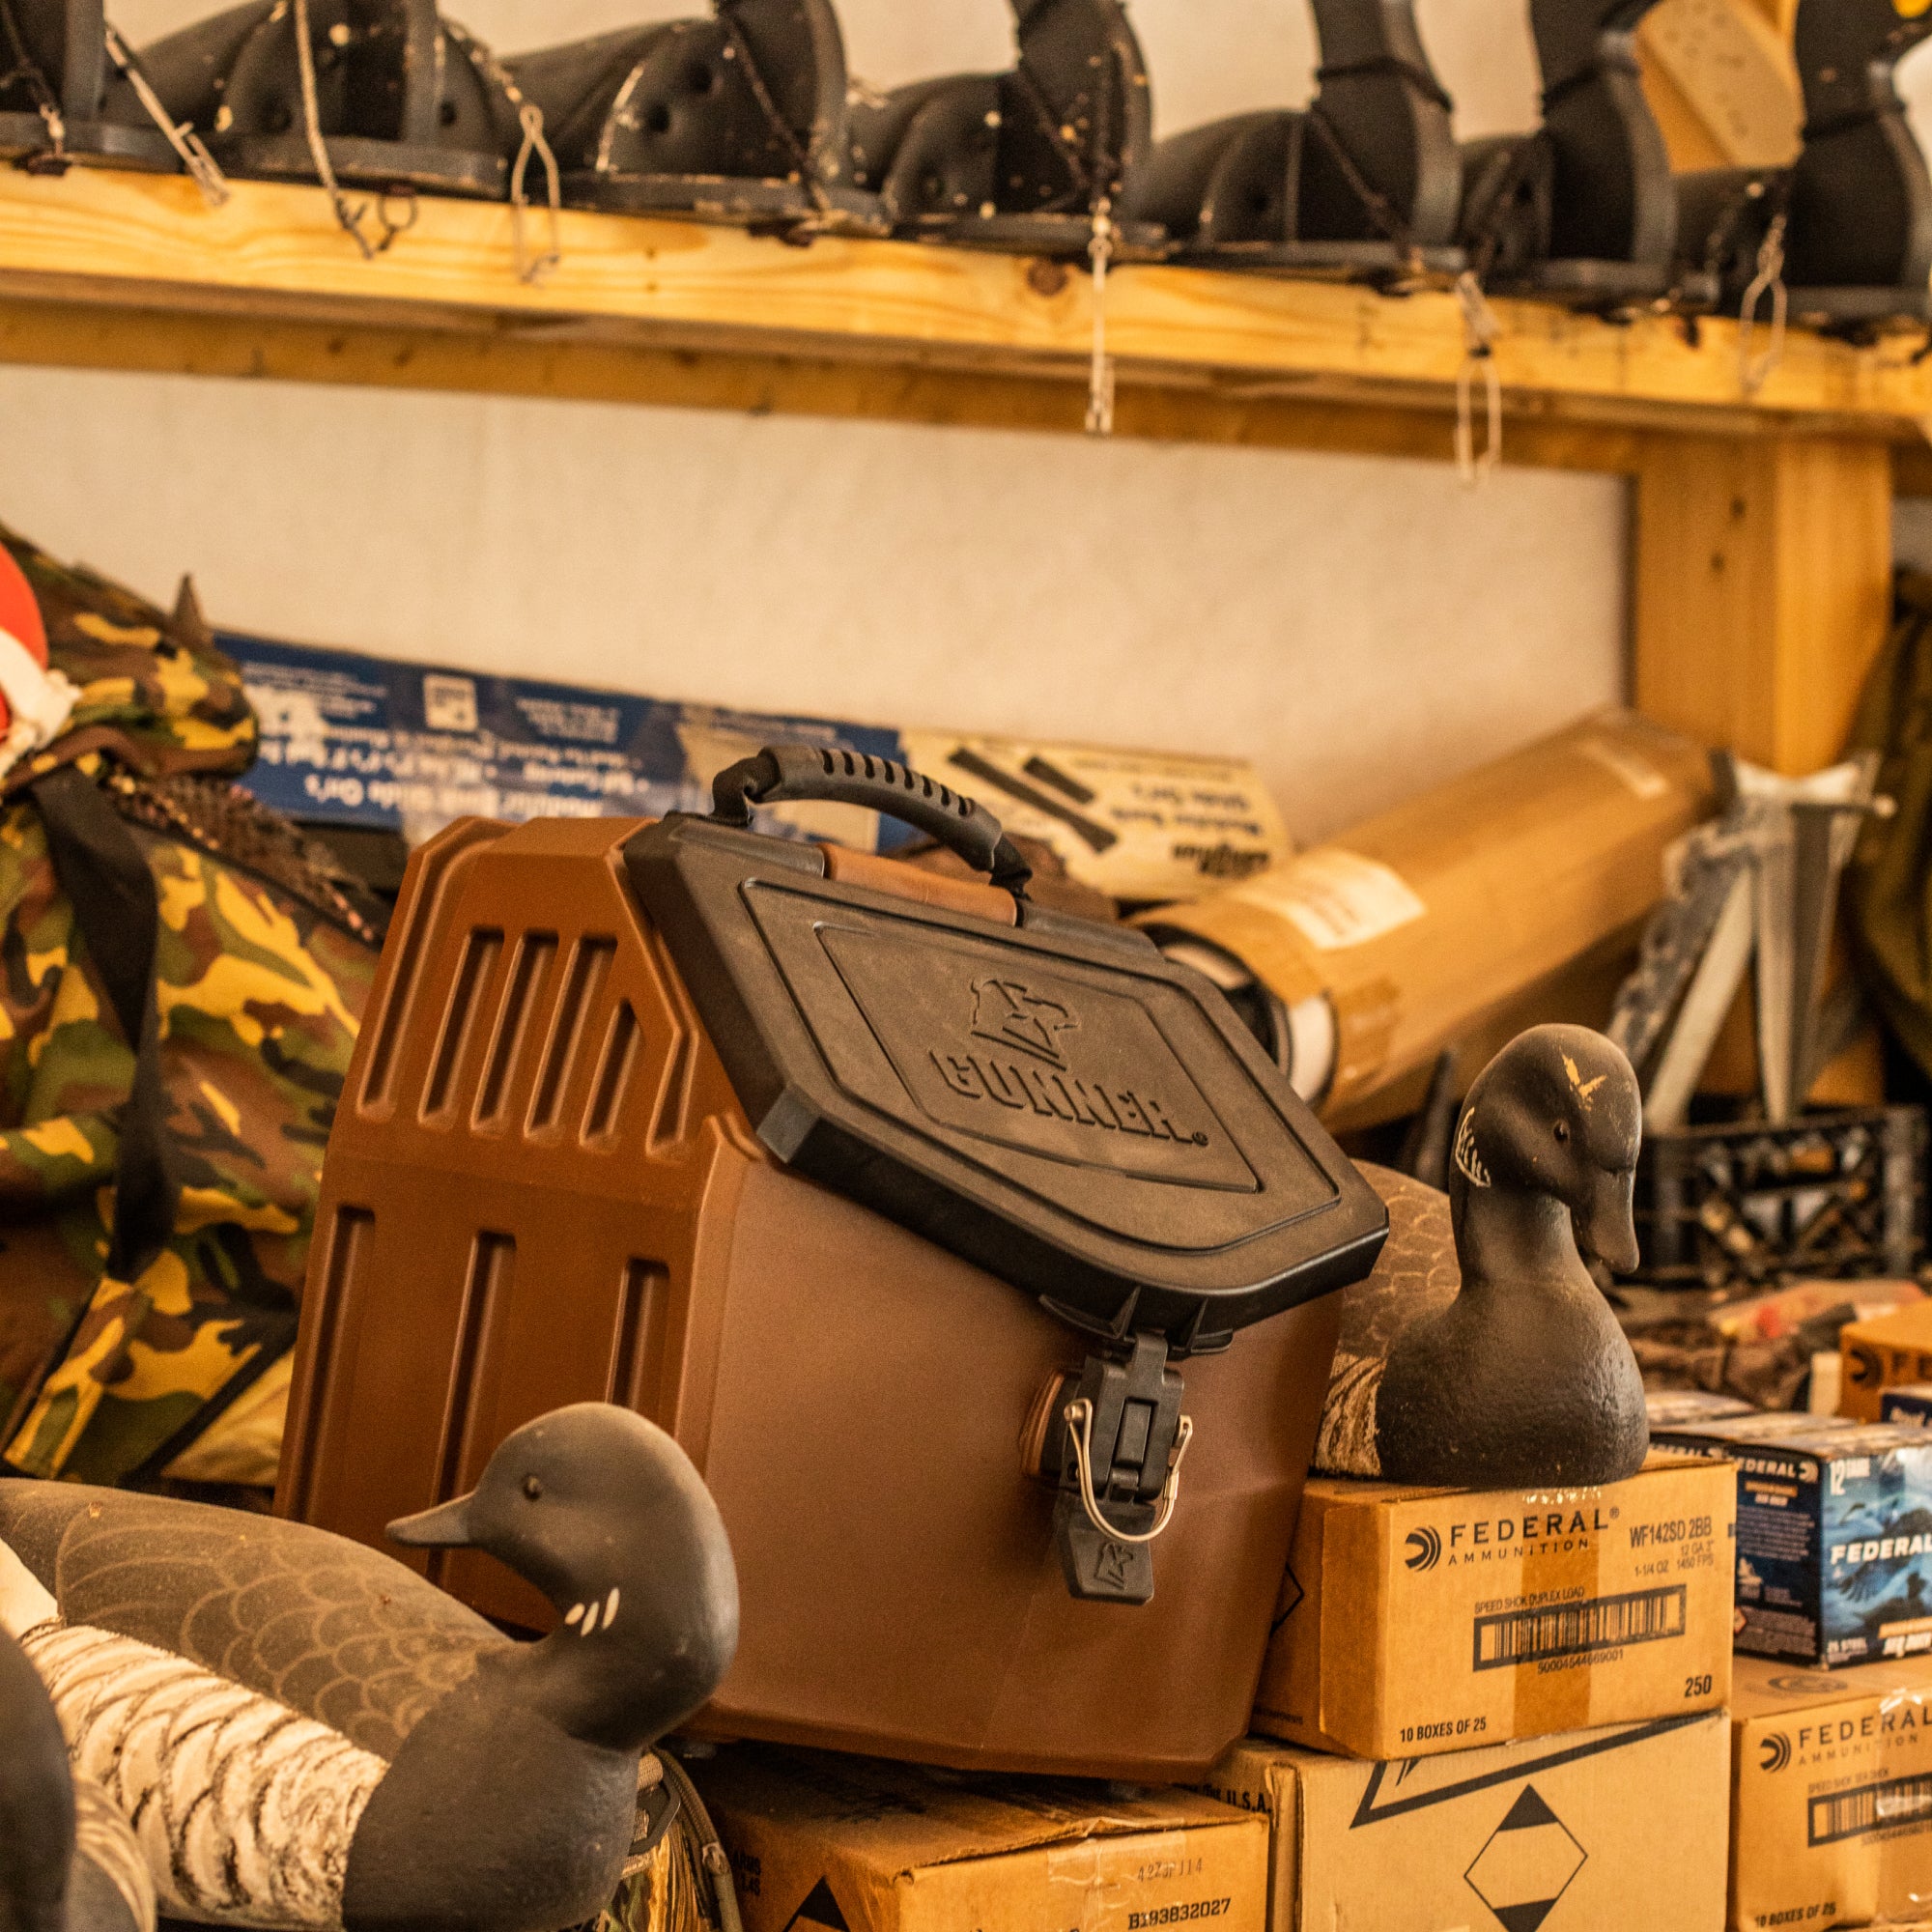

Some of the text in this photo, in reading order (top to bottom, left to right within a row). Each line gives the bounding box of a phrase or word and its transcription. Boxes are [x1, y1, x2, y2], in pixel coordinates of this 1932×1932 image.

[929, 1049, 1196, 1146] GUNNER
[1449, 1508, 1608, 1548] FEDERAL
[1688, 1515, 1712, 1540] 2BB
[1448, 1539, 1590, 1567] AMMUNITION
[1831, 1532, 1932, 1565] FEDERAL
[1563, 1586, 1585, 1601] LOAD
[1685, 1674, 1713, 1698] 250
[1401, 1716, 1488, 1744] 10 BOXES OF 25
[1799, 1705, 1932, 1749] FEDERAL
[1799, 1734, 1918, 1766] AMMUNIION
[1769, 1907, 1804, 1926] BOXES
